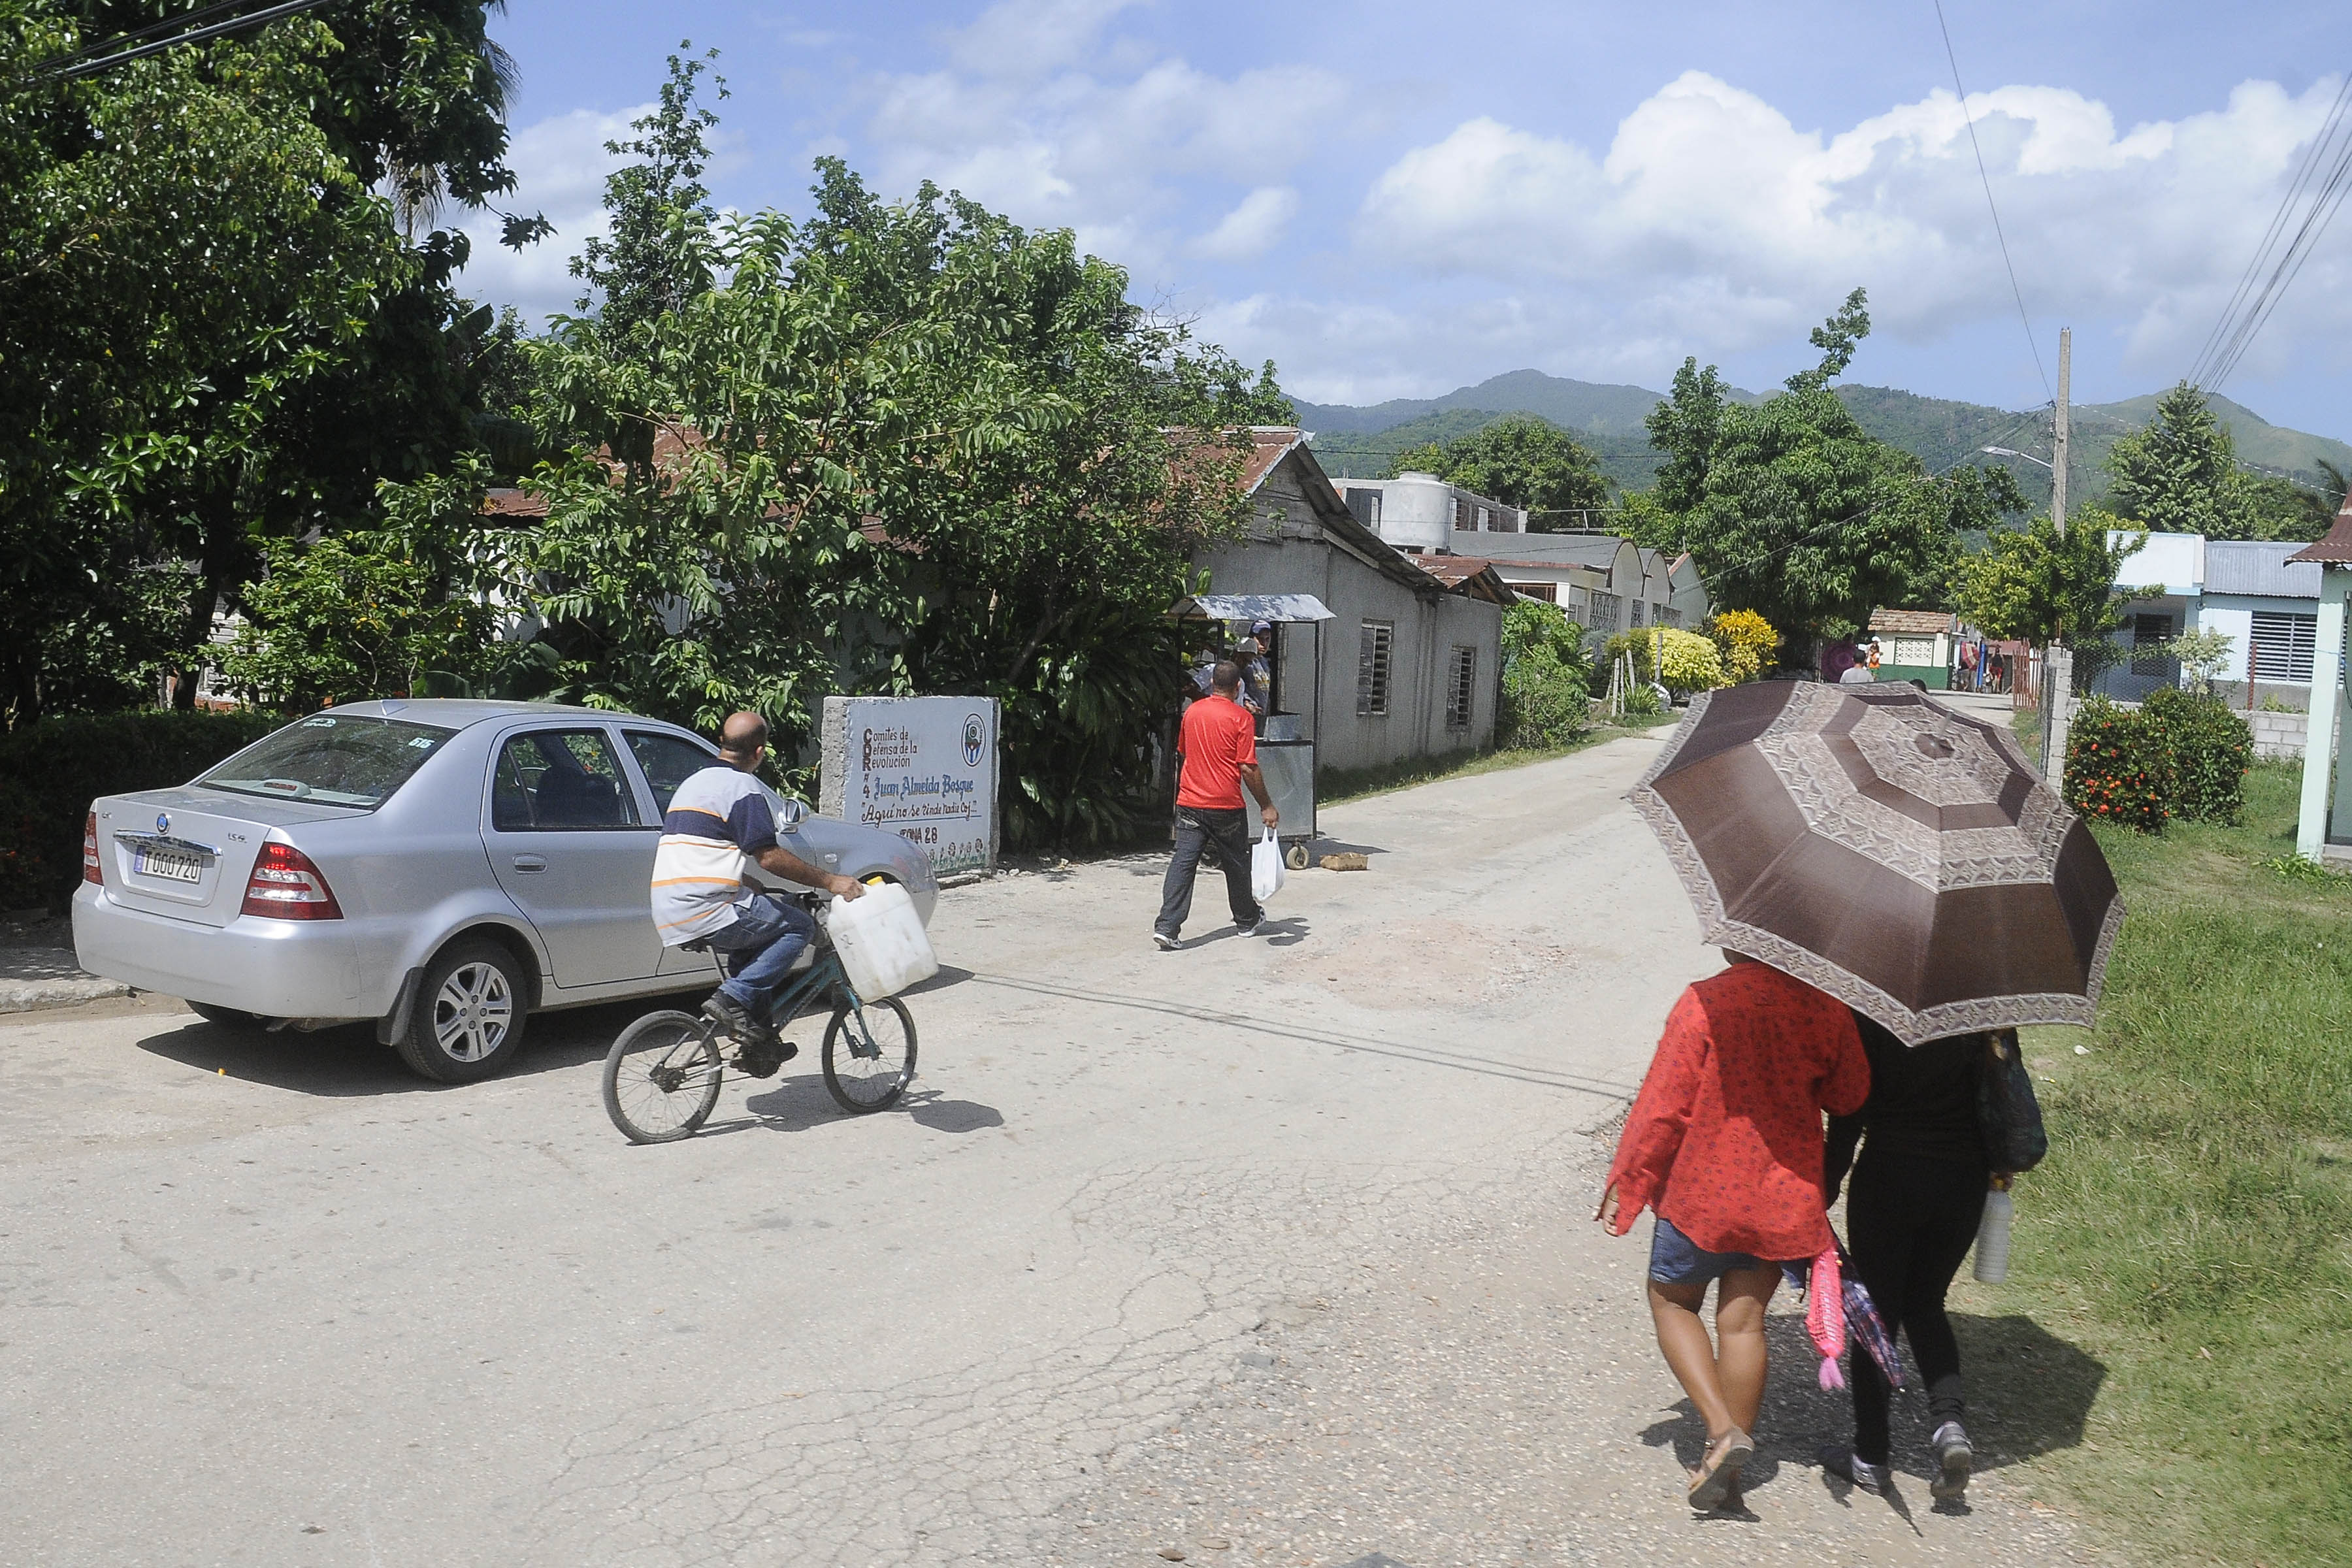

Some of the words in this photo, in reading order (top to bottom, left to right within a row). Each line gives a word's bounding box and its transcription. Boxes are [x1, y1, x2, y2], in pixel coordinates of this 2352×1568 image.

[863, 727, 897, 743] Comités
[900, 725, 908, 740] de
[862, 742, 898, 757] Defensa
[899, 741, 908, 754] de
[910, 740, 917, 753] la
[874, 776, 899, 801] Juan
[941, 774, 973, 800] Bosque
[896, 806, 907, 818] no
[924, 826, 938, 843] 28
